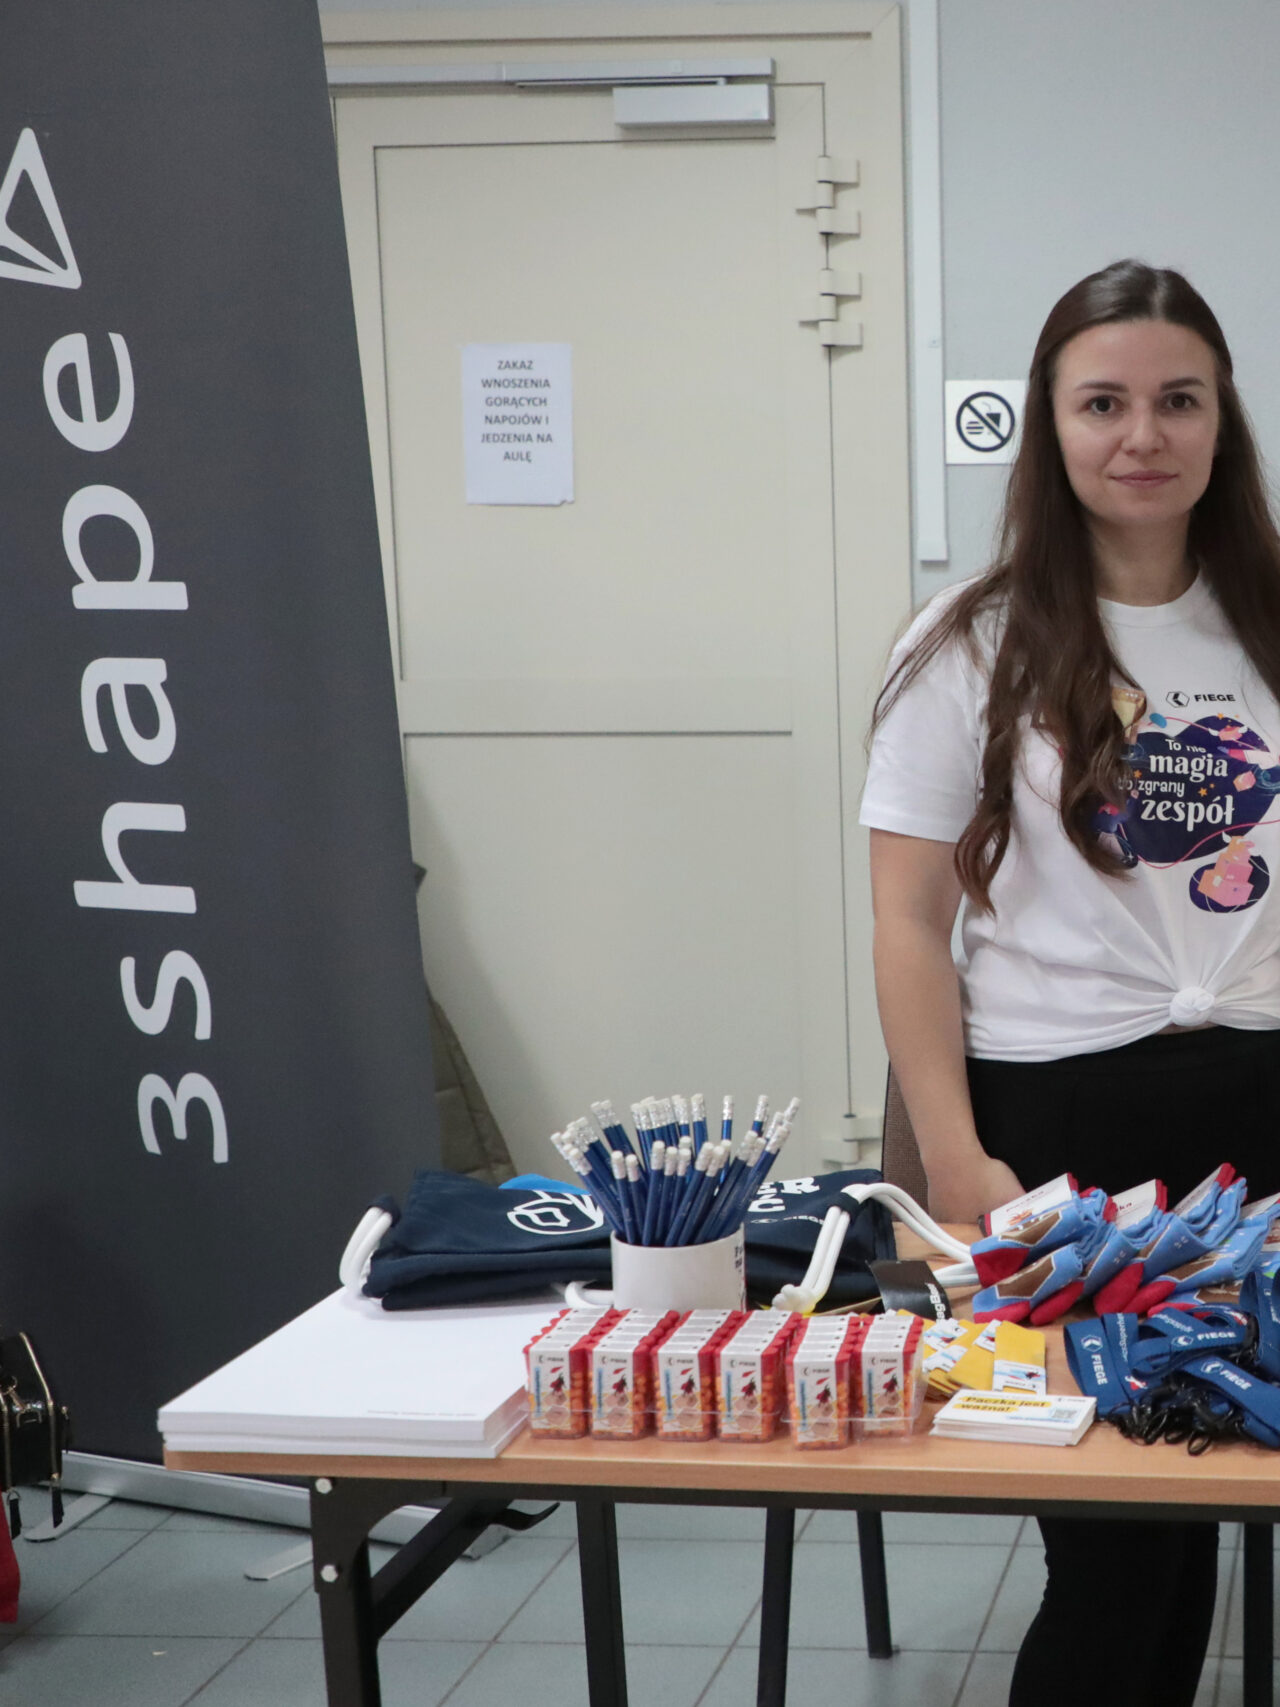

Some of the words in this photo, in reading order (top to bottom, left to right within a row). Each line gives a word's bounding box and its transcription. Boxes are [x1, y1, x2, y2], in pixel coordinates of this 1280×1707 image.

[497, 360, 534, 370] ZAKAZ
[481, 378, 551, 388] WNOSZENIA
[485, 397, 548, 408] GORĄCYCH
[484, 413, 542, 425] NAPOJÓW
[545, 415, 549, 425] I
[481, 433, 533, 443] JEDZENIA
[536, 433, 553, 443] NA
[503, 451, 533, 463] AULĘ
[1194, 694, 1236, 702] FIEGE
[42, 332, 229, 1163] 3shape
[1165, 738, 1182, 751] To
[1186, 745, 1207, 753] nie
[1149, 753, 1229, 783] magia
[1138, 780, 1185, 798] zgrany
[1140, 794, 1236, 832] zespół
[1197, 1331, 1238, 1341] FIEGE
[1091, 1354, 1108, 1385] FIEGE
[1220, 1369, 1253, 1391] FIEGE
